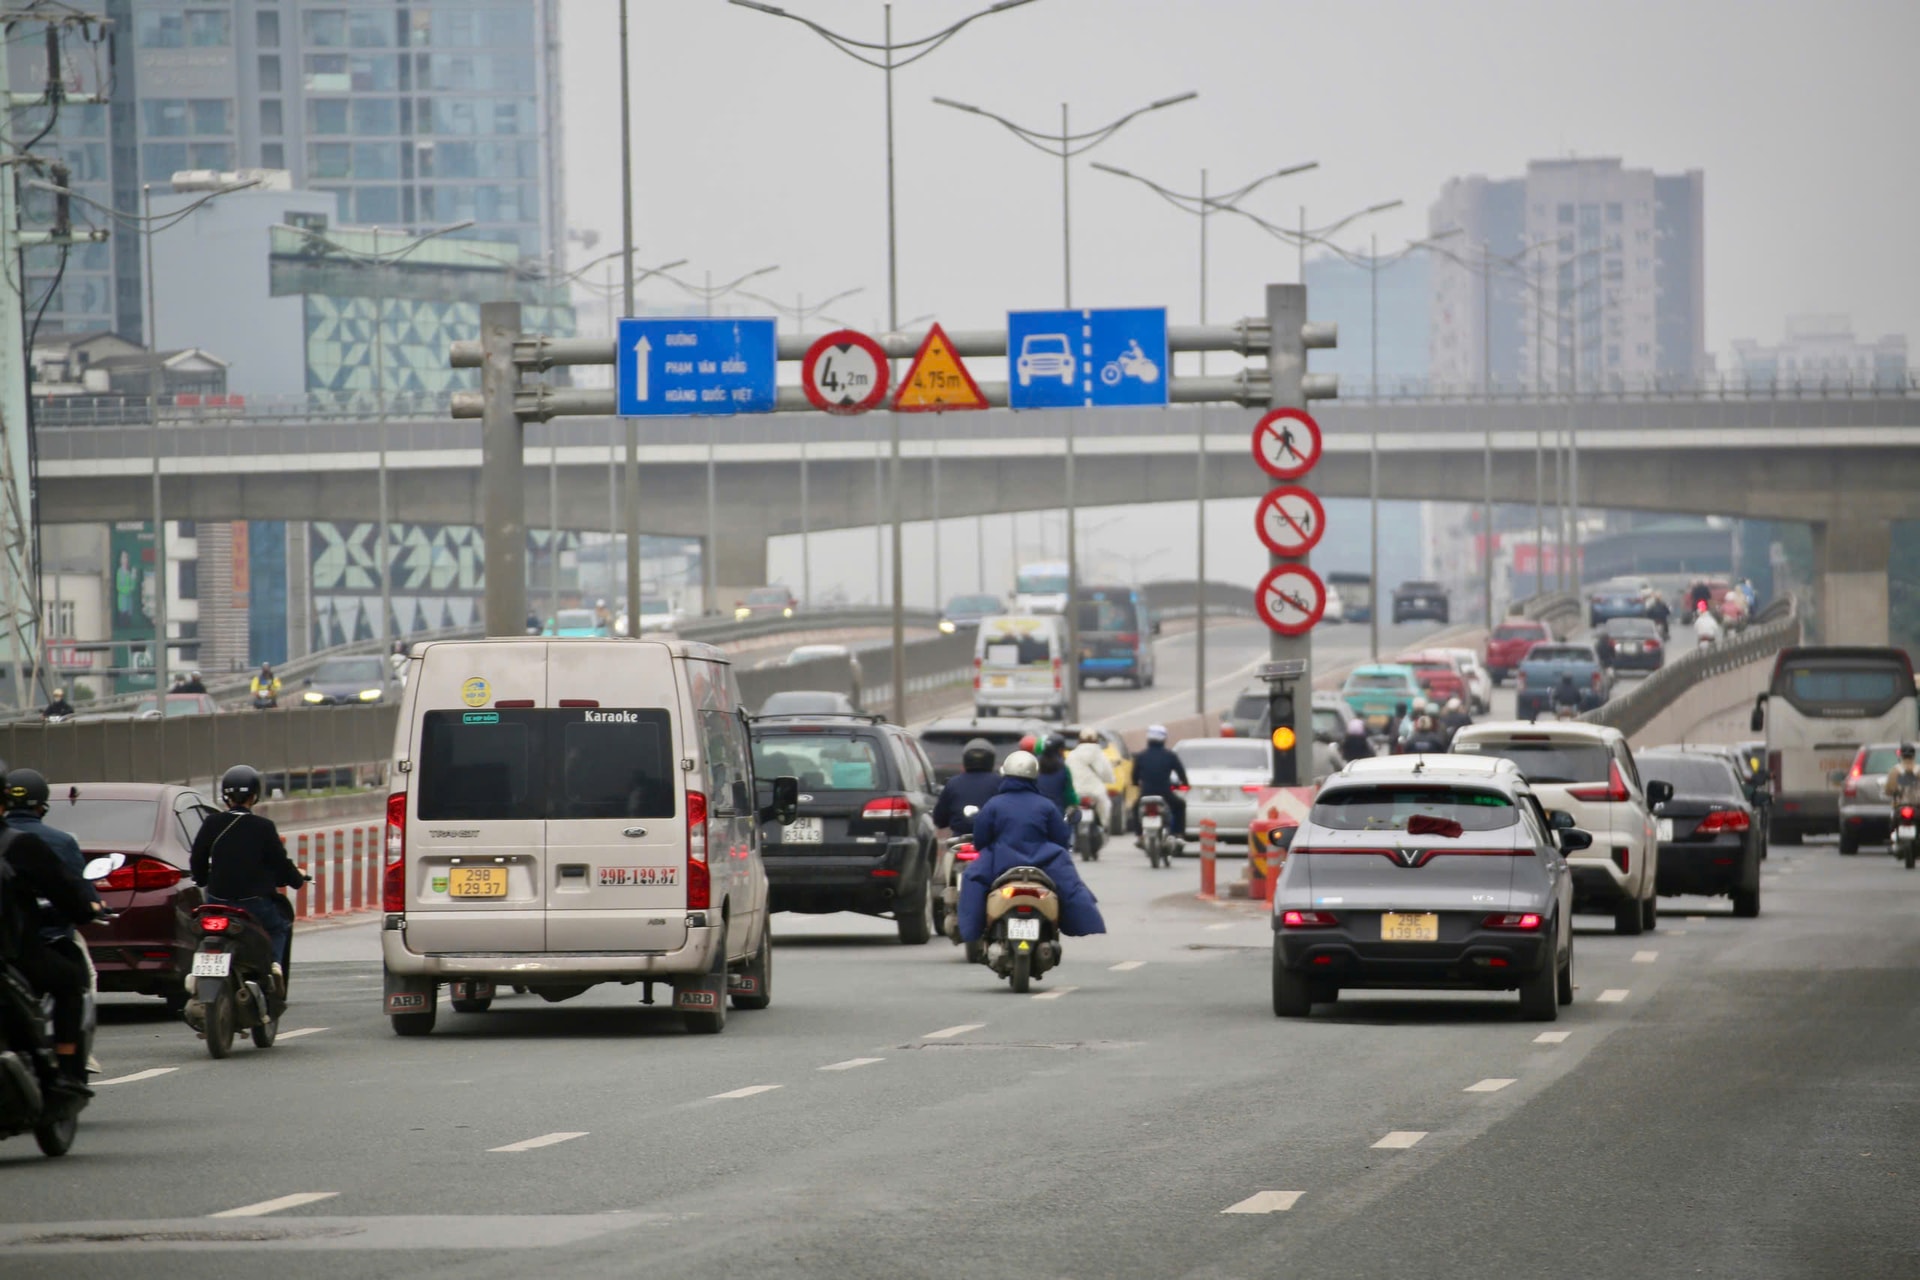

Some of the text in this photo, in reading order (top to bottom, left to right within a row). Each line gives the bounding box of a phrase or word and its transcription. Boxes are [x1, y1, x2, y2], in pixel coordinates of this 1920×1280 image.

[584, 710, 638, 723] Karaoke
[466, 869, 491, 881] 29B
[600, 868, 676, 885] 29B-129.37
[457, 882, 501, 895] 129.37
[393, 995, 422, 1007] ARB
[682, 993, 712, 1005] ARB
